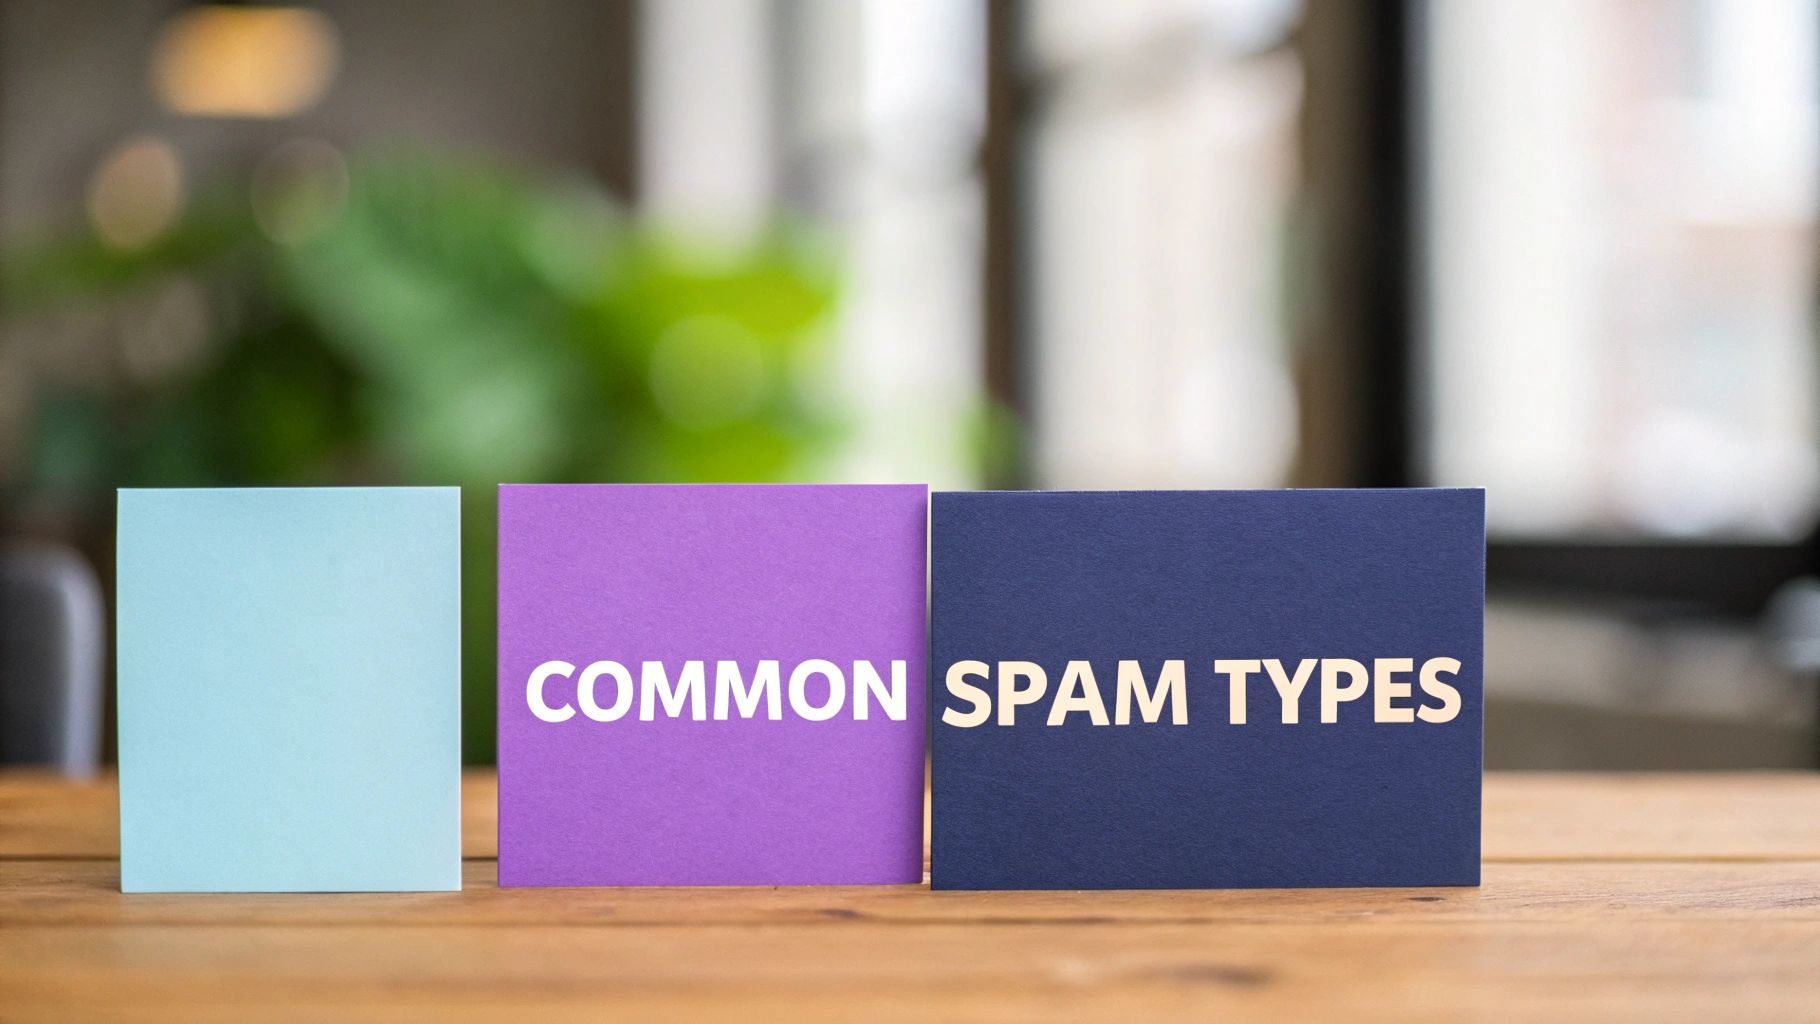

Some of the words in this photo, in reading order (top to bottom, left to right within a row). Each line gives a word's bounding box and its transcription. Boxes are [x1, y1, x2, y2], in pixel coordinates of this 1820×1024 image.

[526, 659, 907, 723] COMMON
[941, 660, 1188, 728] SPAM
[1214, 657, 1462, 725] TYPES
